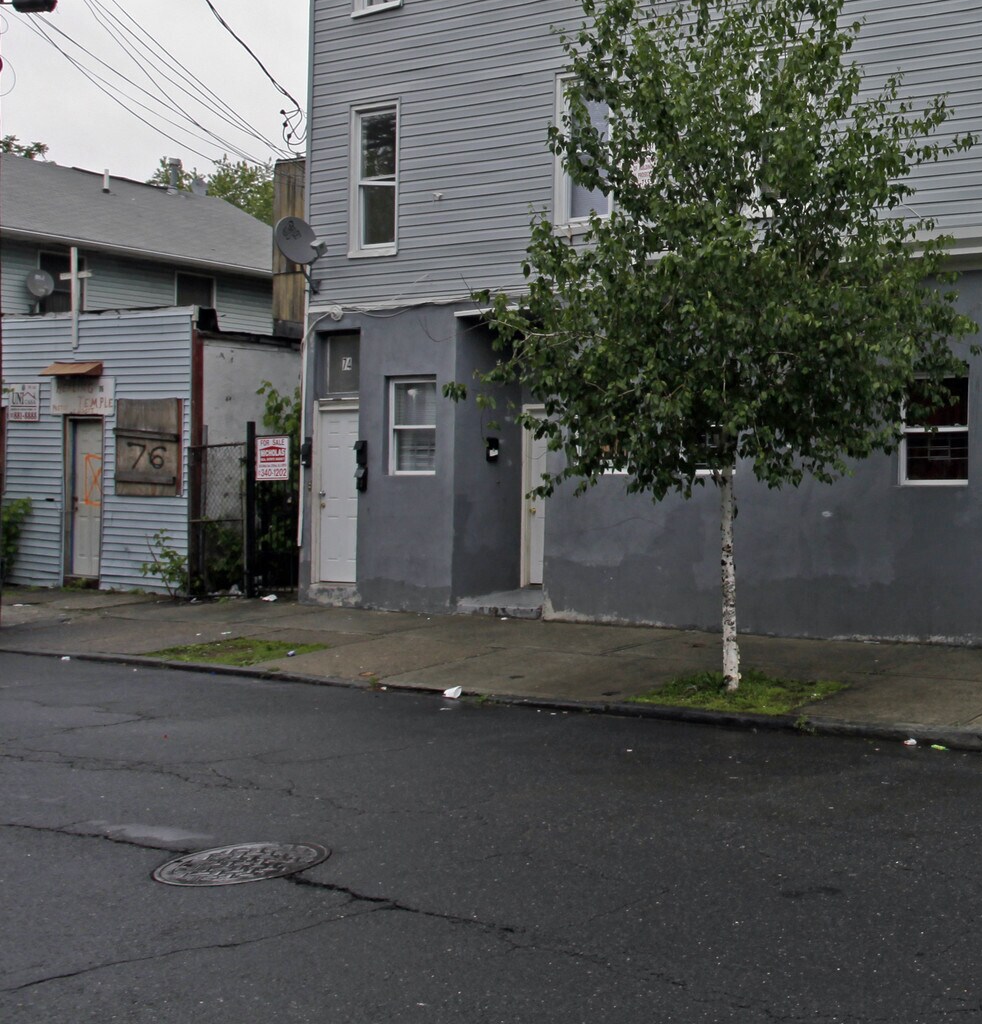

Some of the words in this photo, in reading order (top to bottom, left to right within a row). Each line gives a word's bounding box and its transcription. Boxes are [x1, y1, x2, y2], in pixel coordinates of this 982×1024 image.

[79, 396, 113, 409] TEMPLE
[273, 438, 285, 446] SALE
[127, 441, 167, 470] 76
